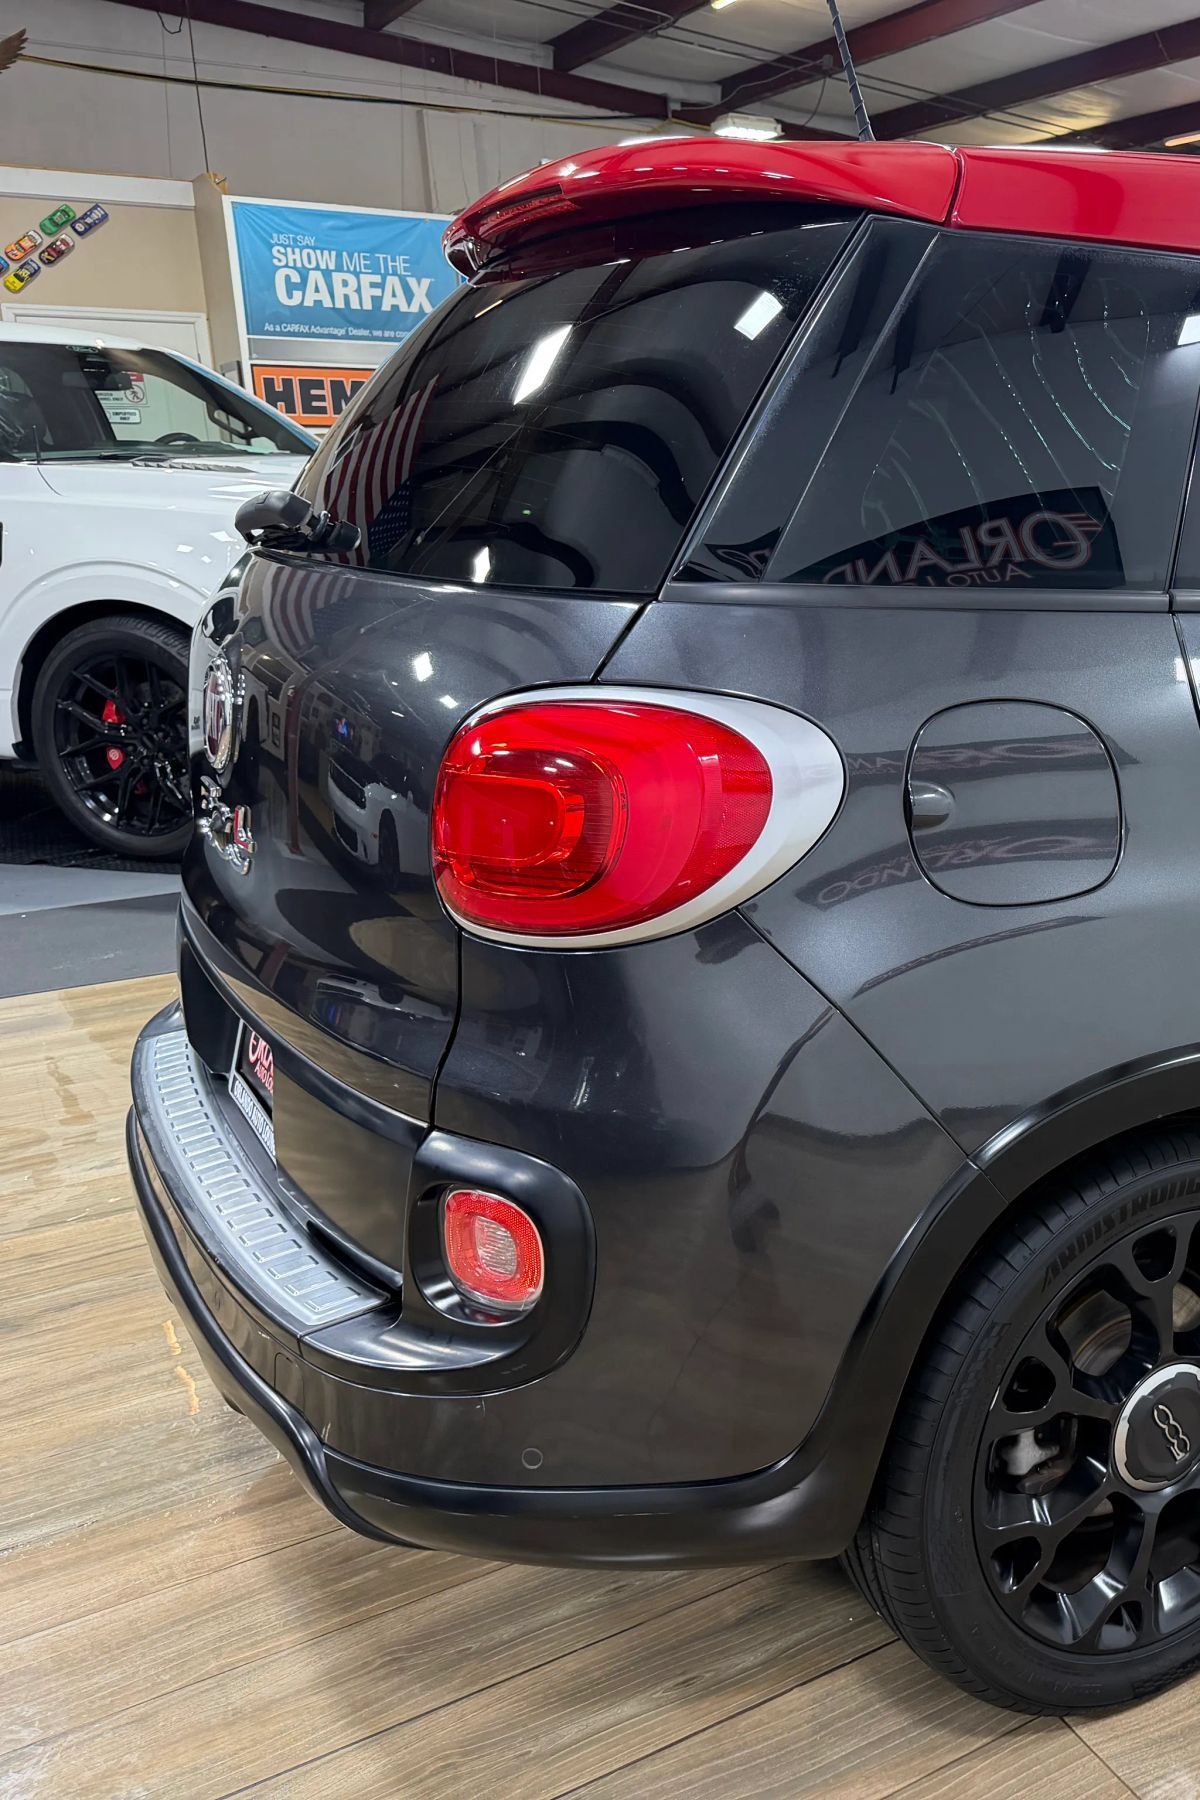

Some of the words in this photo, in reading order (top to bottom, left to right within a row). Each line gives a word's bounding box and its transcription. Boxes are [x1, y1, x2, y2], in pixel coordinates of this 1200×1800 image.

[270, 233, 293, 246] JUST
[296, 235, 316, 246] SAY
[271, 245, 336, 270] SHOW
[342, 251, 372, 273] ME
[375, 253, 411, 276] THE
[274, 267, 434, 314] CARFAX
[264, 322, 273, 331] As
[281, 323, 310, 333] CARFAX
[384, 330, 395, 338] are
